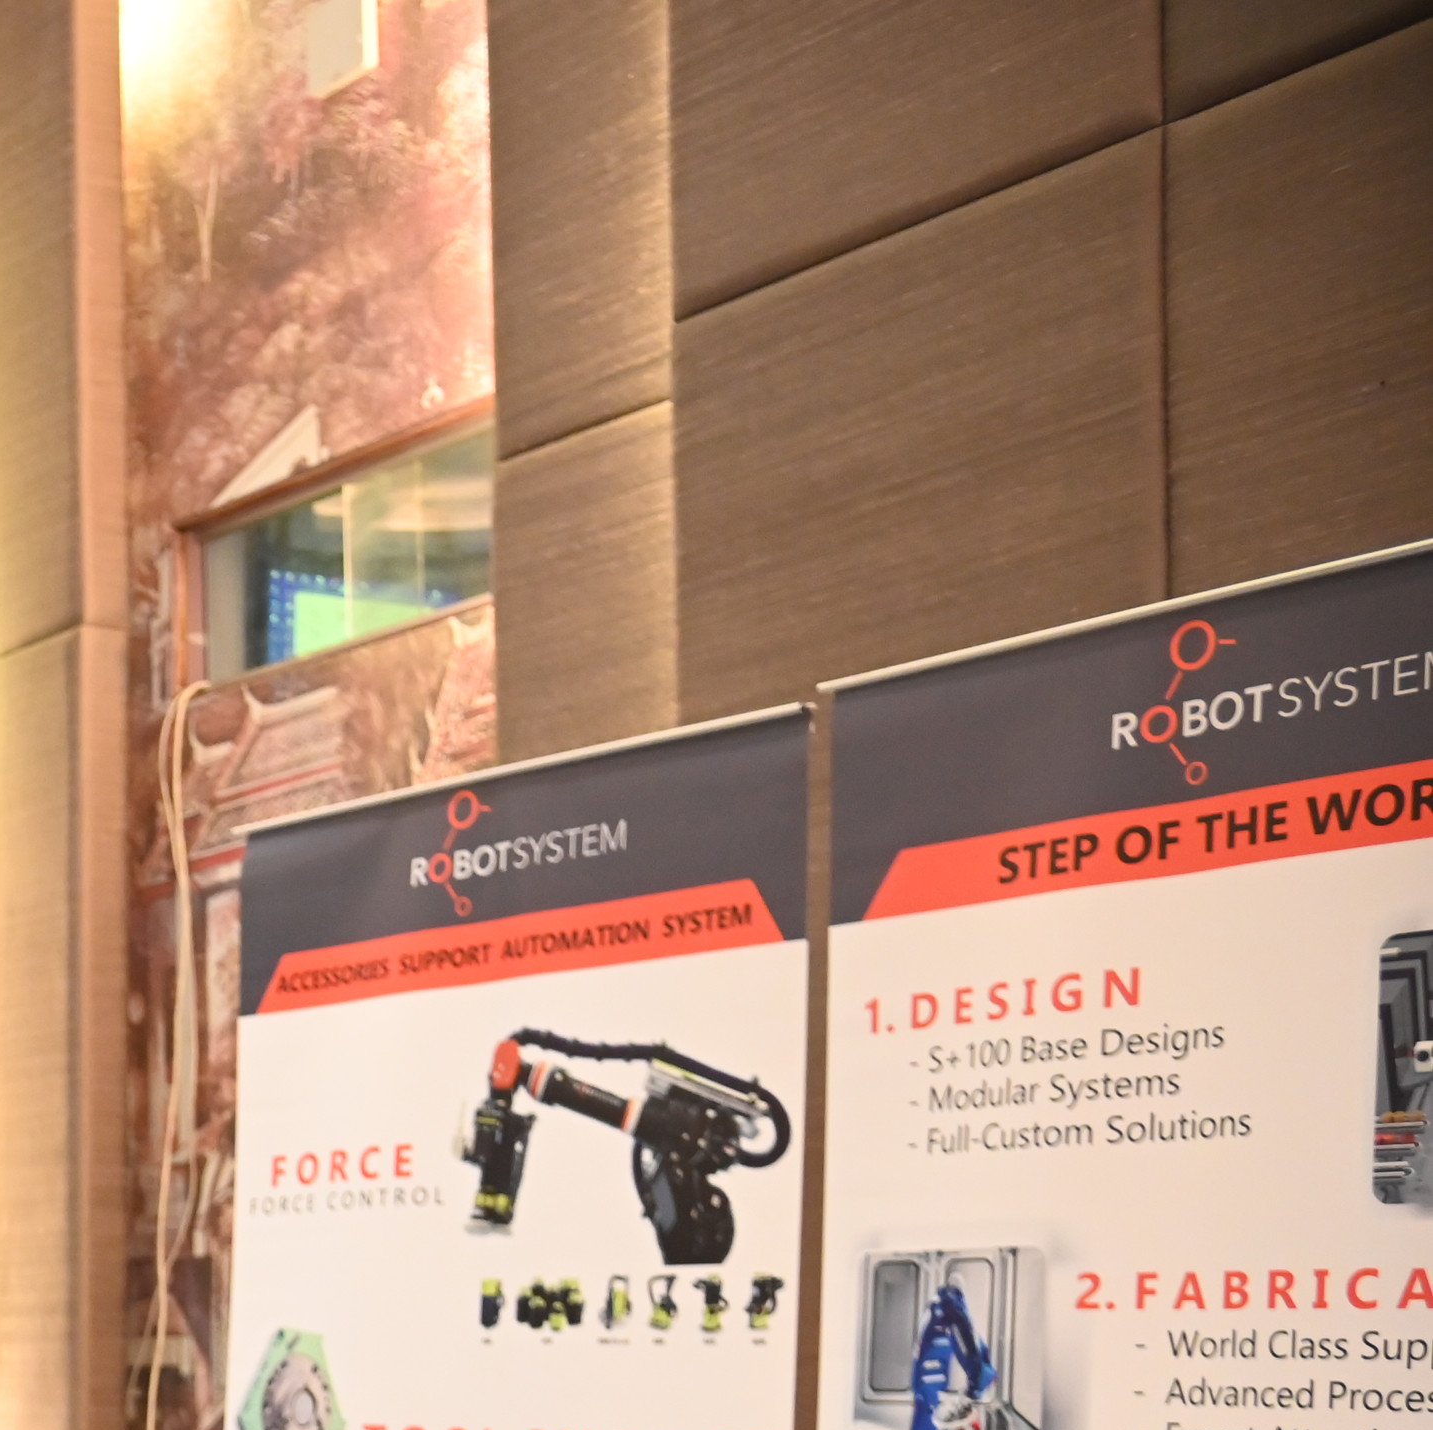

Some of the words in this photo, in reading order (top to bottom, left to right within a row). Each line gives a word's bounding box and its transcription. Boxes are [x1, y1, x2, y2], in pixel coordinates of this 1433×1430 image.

[1111, 651, 1433, 751] ROBOTSYSTE
[410, 818, 629, 888] ROBOTSYSTEM
[999, 834, 1099, 884] STEP
[1115, 821, 1181, 864] OF
[1197, 802, 1288, 853] THE
[276, 957, 389, 995] ACCESSORIES
[399, 944, 492, 976] SUPPORT
[502, 920, 651, 959] AUTOMATION
[663, 903, 754, 938] SYSTEM
[928, 1040, 1013, 1074] S+100
[1021, 1032, 1088, 1064] Base
[1100, 1024, 1225, 1062] Designs
[928, 1080, 1041, 1114] Modular
[1049, 1068, 1181, 1107] Systems
[926, 1115, 1093, 1155] Full-Custom
[1106, 1109, 1252, 1145] Solutions
[271, 1143, 415, 1187] FORCE
[249, 1191, 317, 1216] FORCE
[327, 1186, 445, 1212] CONTROL
[1167, 1329, 1258, 1361] World
[1268, 1330, 1348, 1361] Class
[1361, 1330, 1433, 1370] Sup
[1165, 1377, 1315, 1410] Advanced
